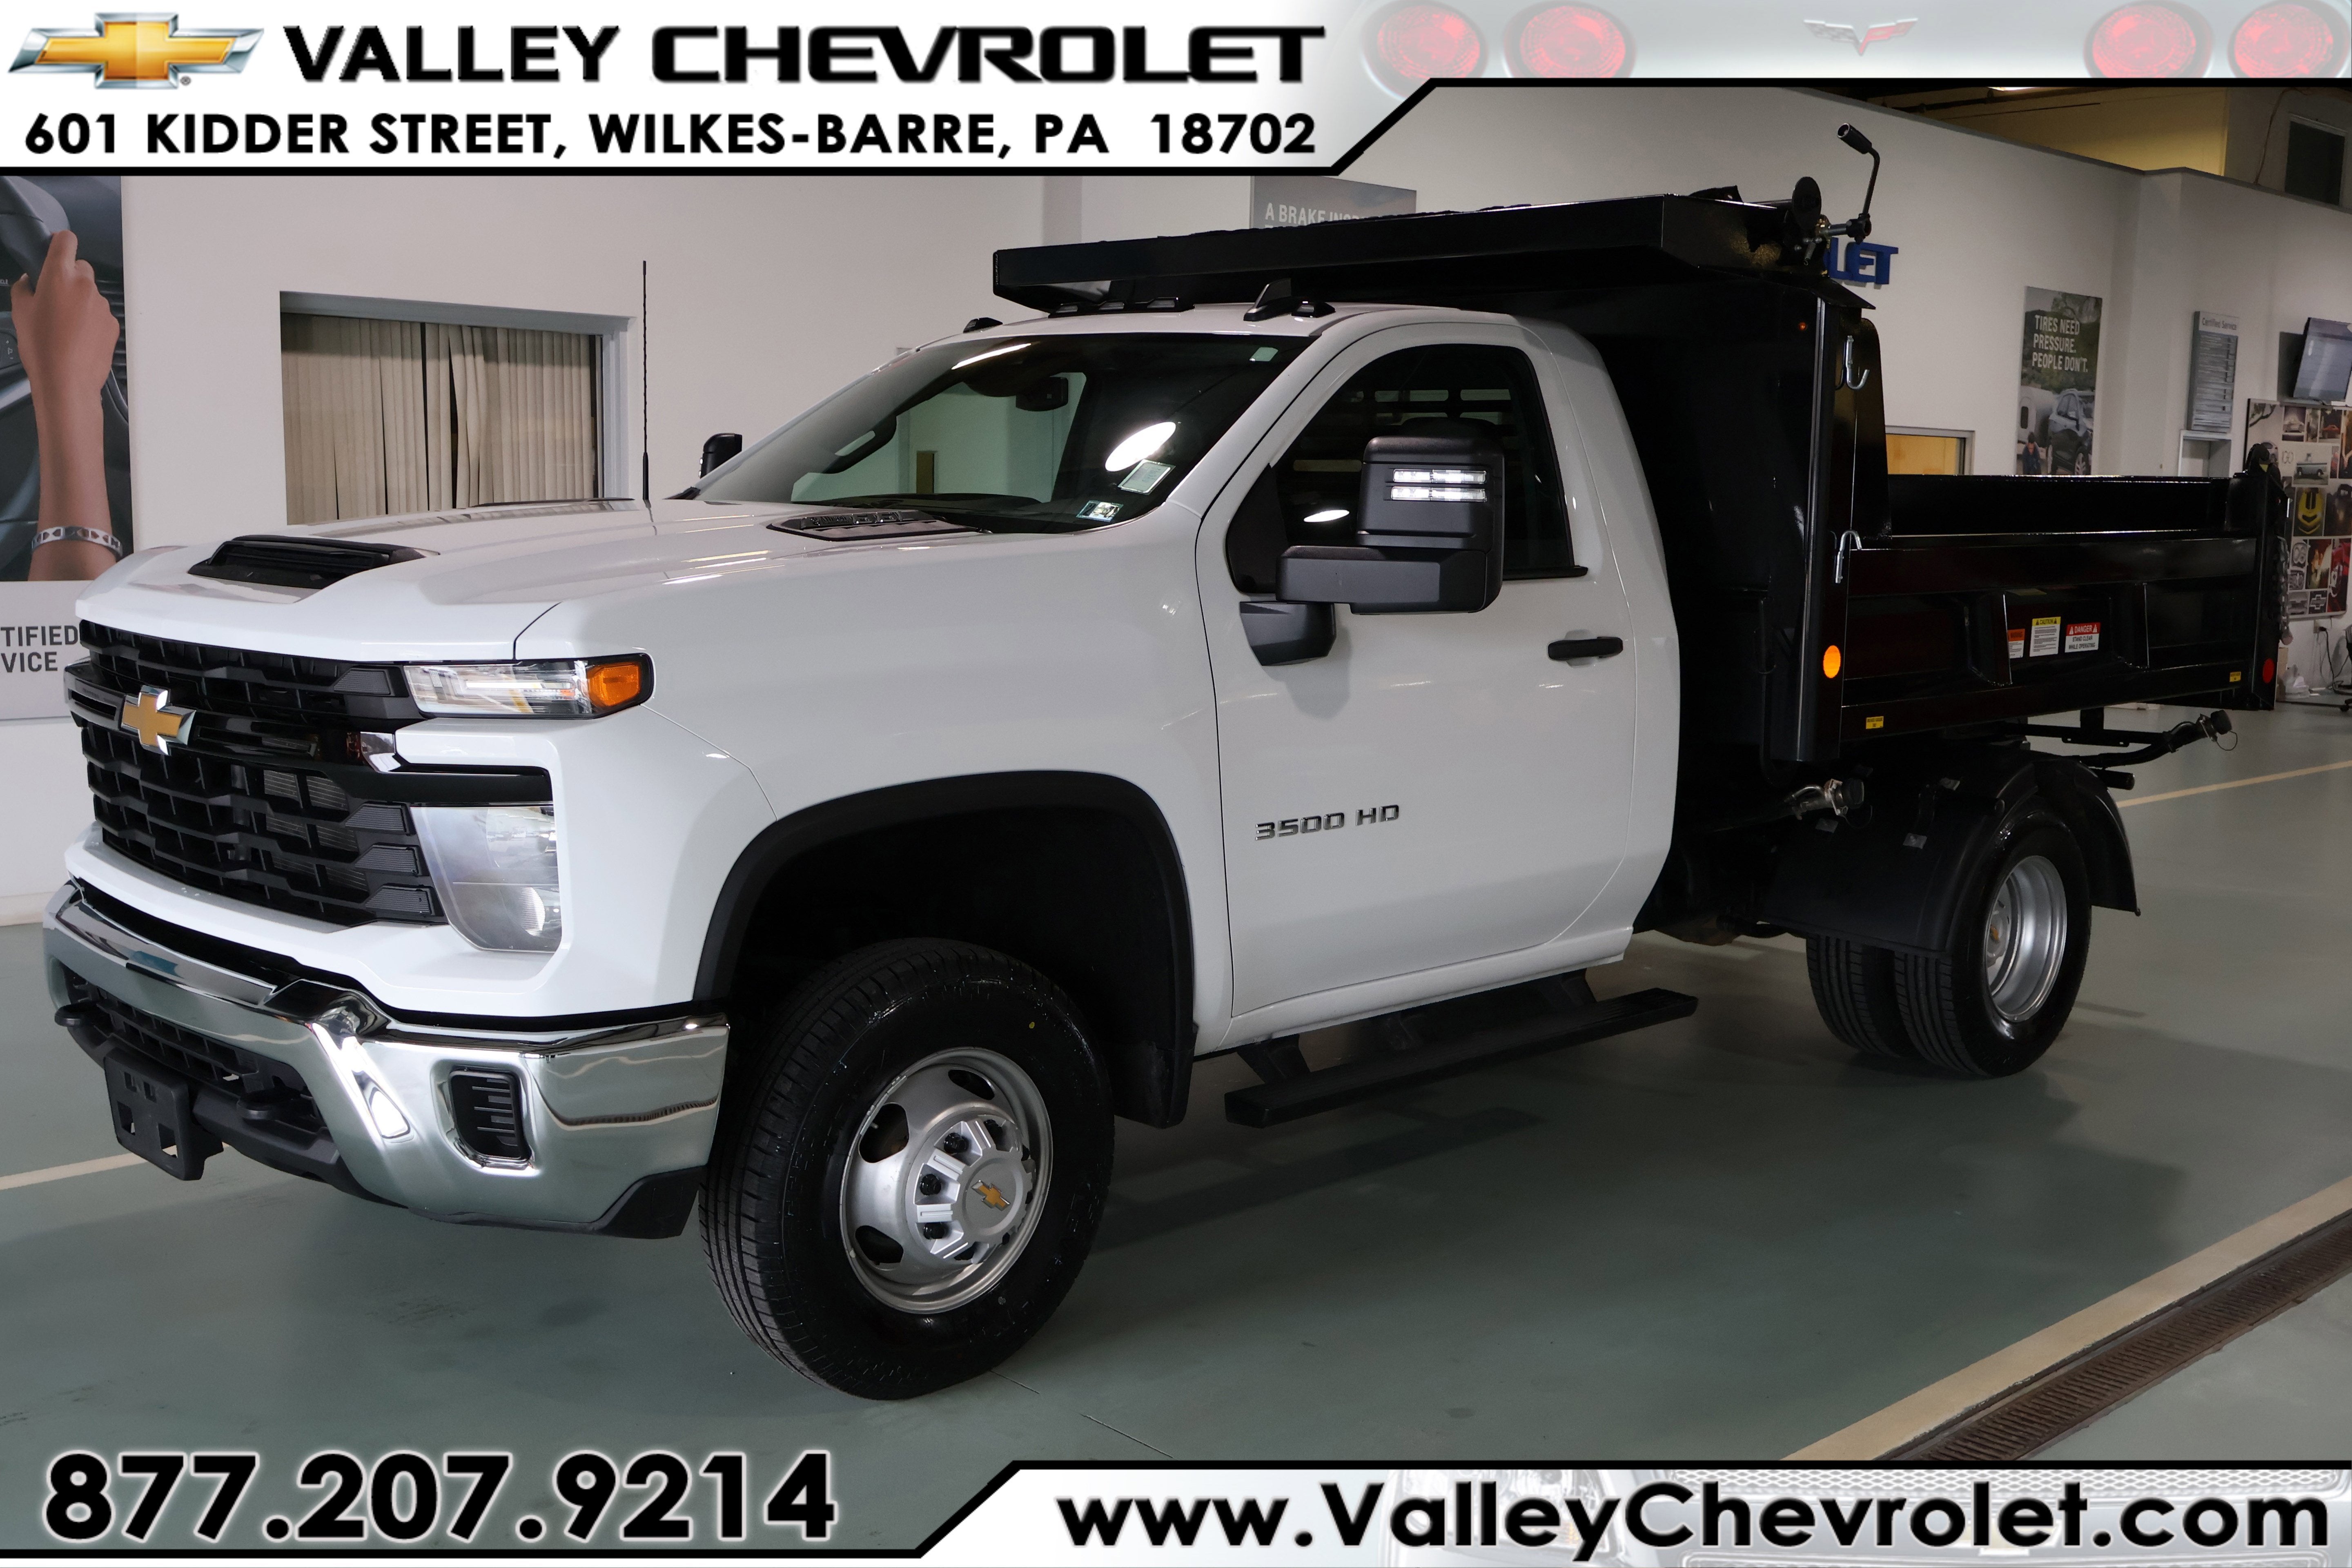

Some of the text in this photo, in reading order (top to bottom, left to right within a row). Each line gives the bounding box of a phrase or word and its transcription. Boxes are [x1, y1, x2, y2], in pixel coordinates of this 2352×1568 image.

[1265, 203, 1274, 221] A
[1279, 204, 1326, 225] BRAKE
[1824, 237, 1898, 284] LET
[2035, 314, 2080, 335] TIRES NEED
[2033, 333, 2076, 354] PRESSURE.
[2032, 352, 2088, 373] PEOPLE DON'T.
[0, 625, 79, 647] TIFIED
[2075, 625, 2093, 633] DANGER
[1, 651, 58, 673] VICE
[1255, 804, 1399, 841] 3500 HD
